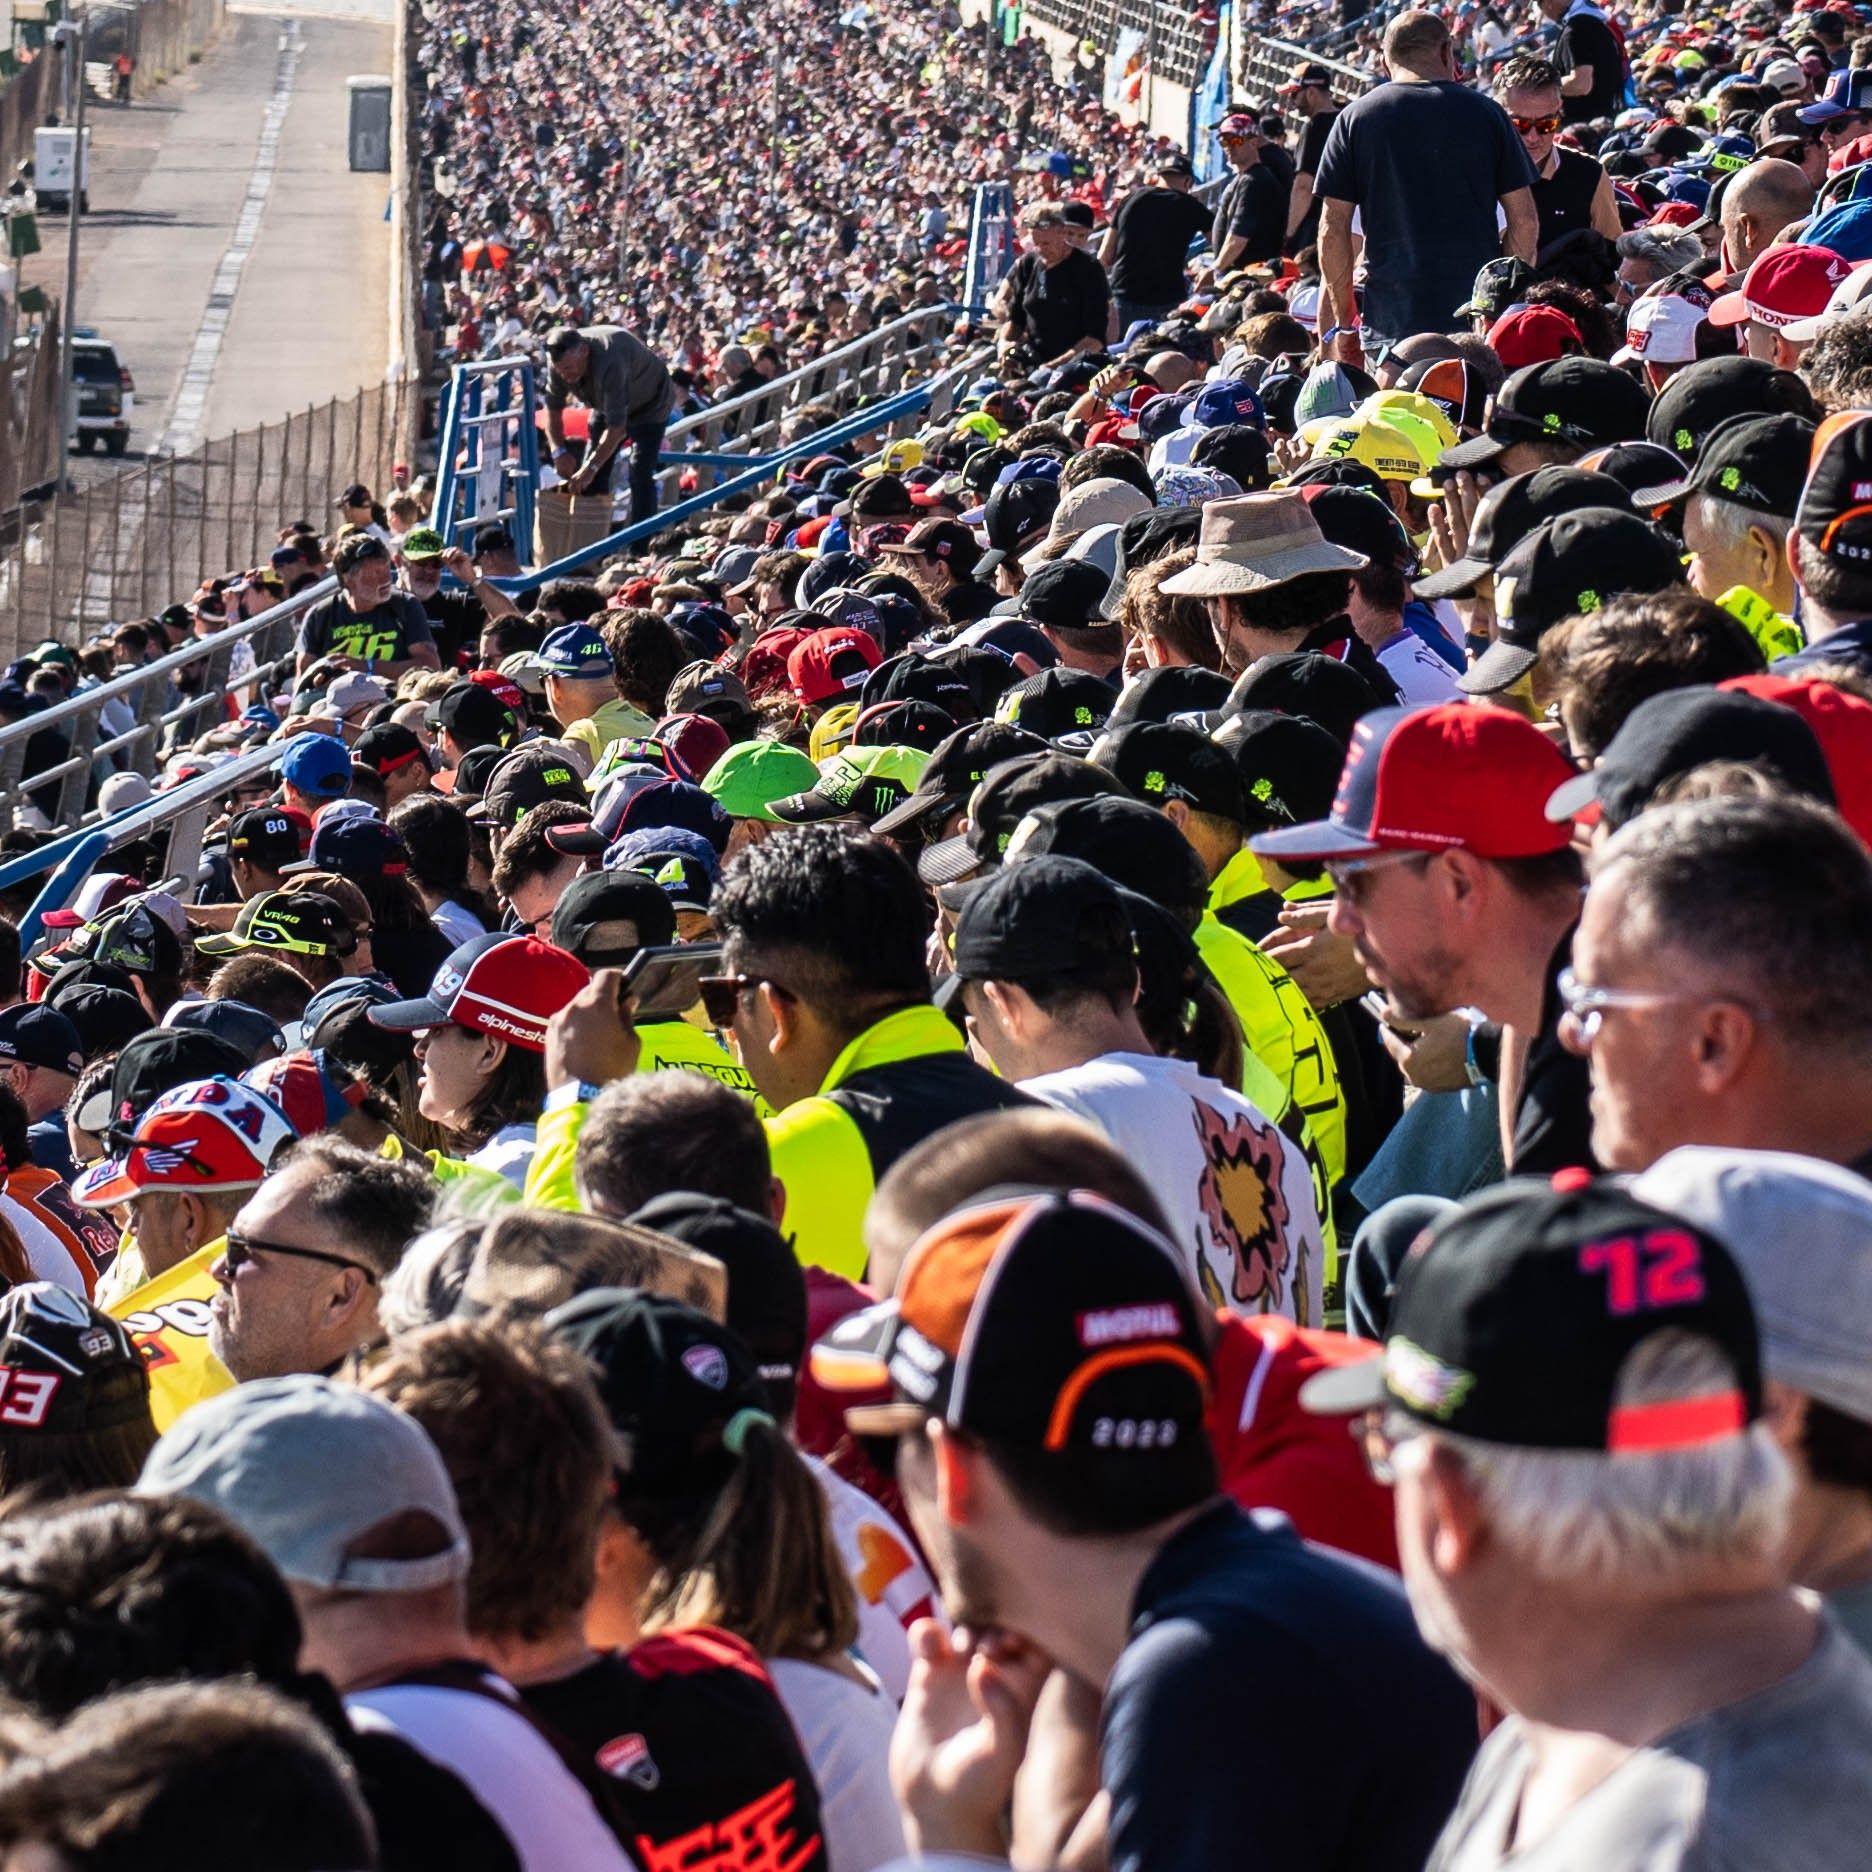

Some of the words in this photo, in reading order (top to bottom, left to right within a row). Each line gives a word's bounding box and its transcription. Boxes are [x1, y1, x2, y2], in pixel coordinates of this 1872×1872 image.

[325, 630, 398, 662] 46
[579, 641, 602, 656] 46
[265, 819, 288, 834] 80
[1083, 1303, 1181, 1346] MOTUL
[89, 1341, 110, 1357] 93
[1091, 1415, 1179, 1449] 2023
